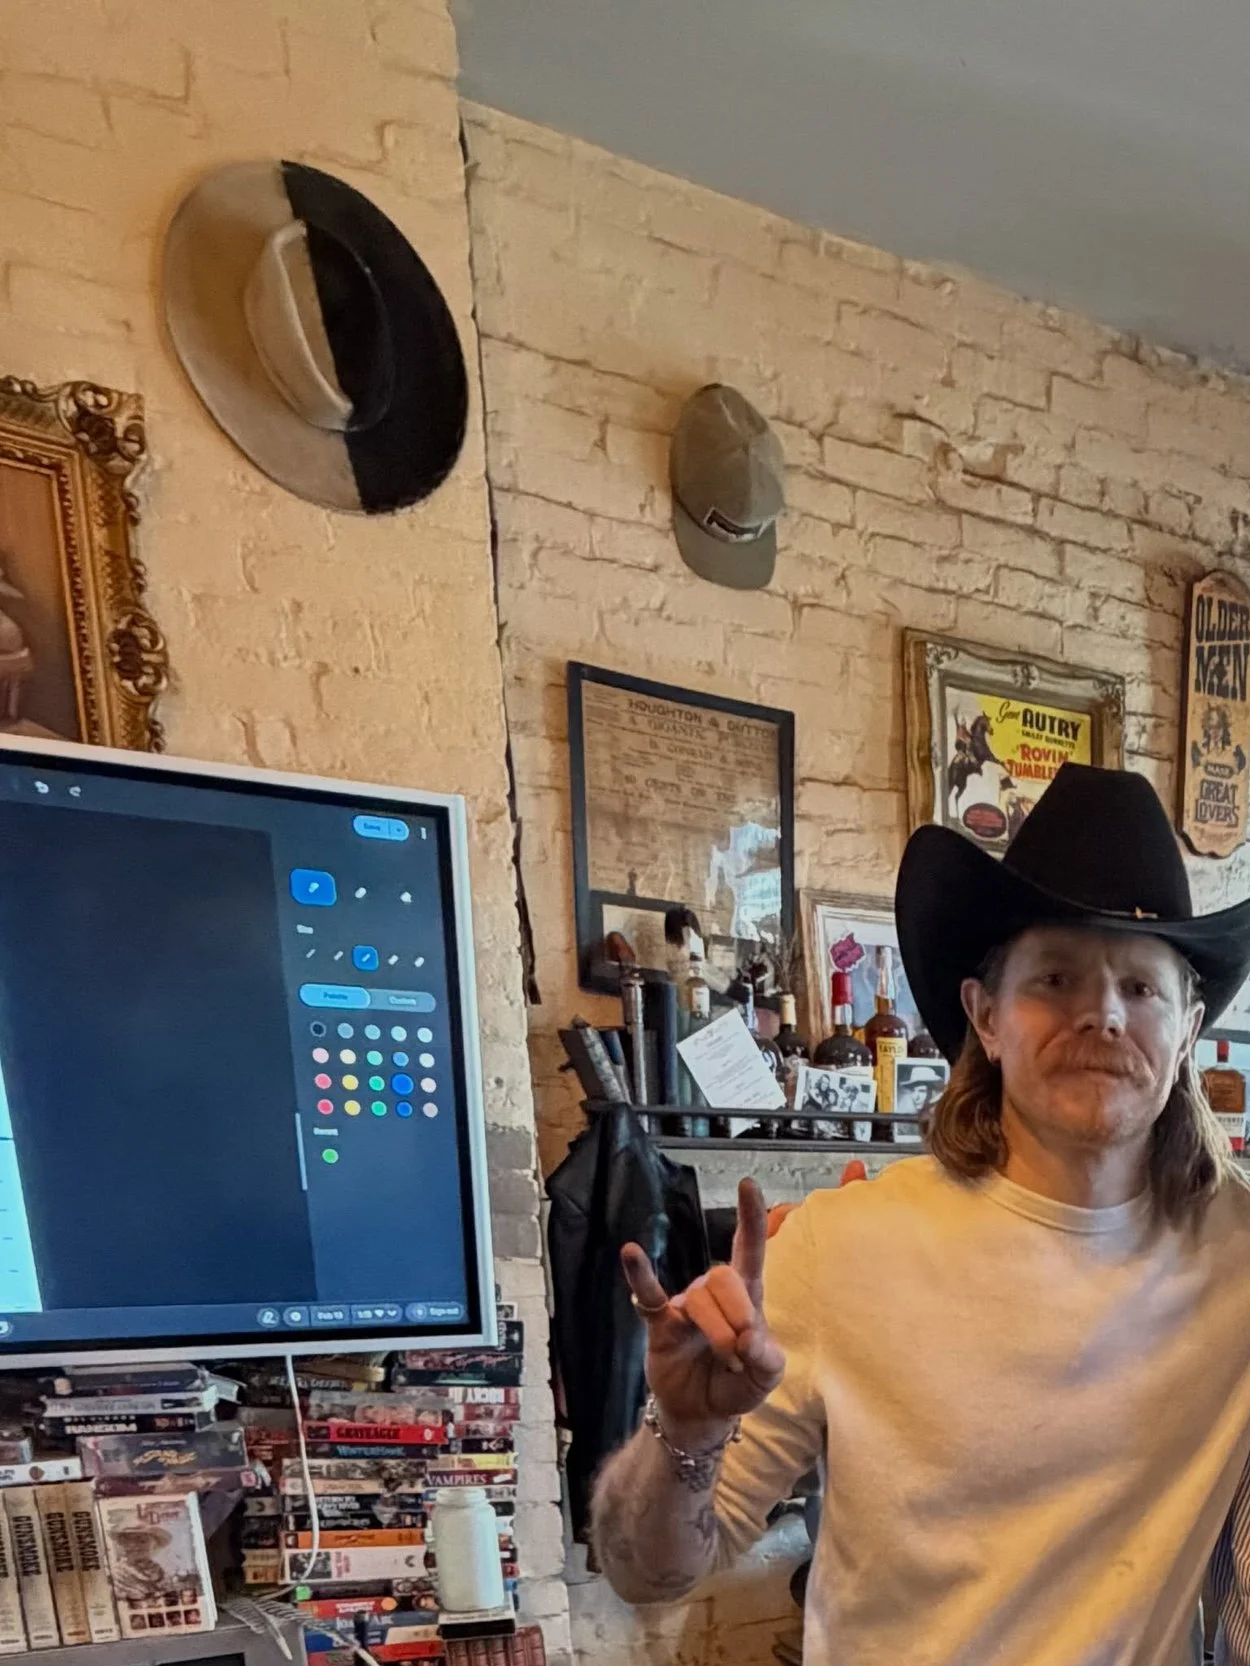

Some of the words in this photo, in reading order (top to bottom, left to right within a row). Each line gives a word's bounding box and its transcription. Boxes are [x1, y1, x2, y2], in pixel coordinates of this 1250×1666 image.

[1195, 594, 1250, 643] OLDER
[1194, 642, 1250, 702] MEN
[995, 701, 1020, 723] Gene
[1021, 707, 1081, 741] AUTRY
[1004, 759, 1057, 780] TUMBLE
[1200, 778, 1238, 801] GREAT
[1195, 800, 1239, 828] LOVERS
[424, 1472, 488, 1486] VAMPIRES
[12, 1516, 41, 1577] GUNSMOKE
[46, 1511, 75, 1573] GUNSMOKE
[72, 1511, 101, 1571] GUNSMOKE
